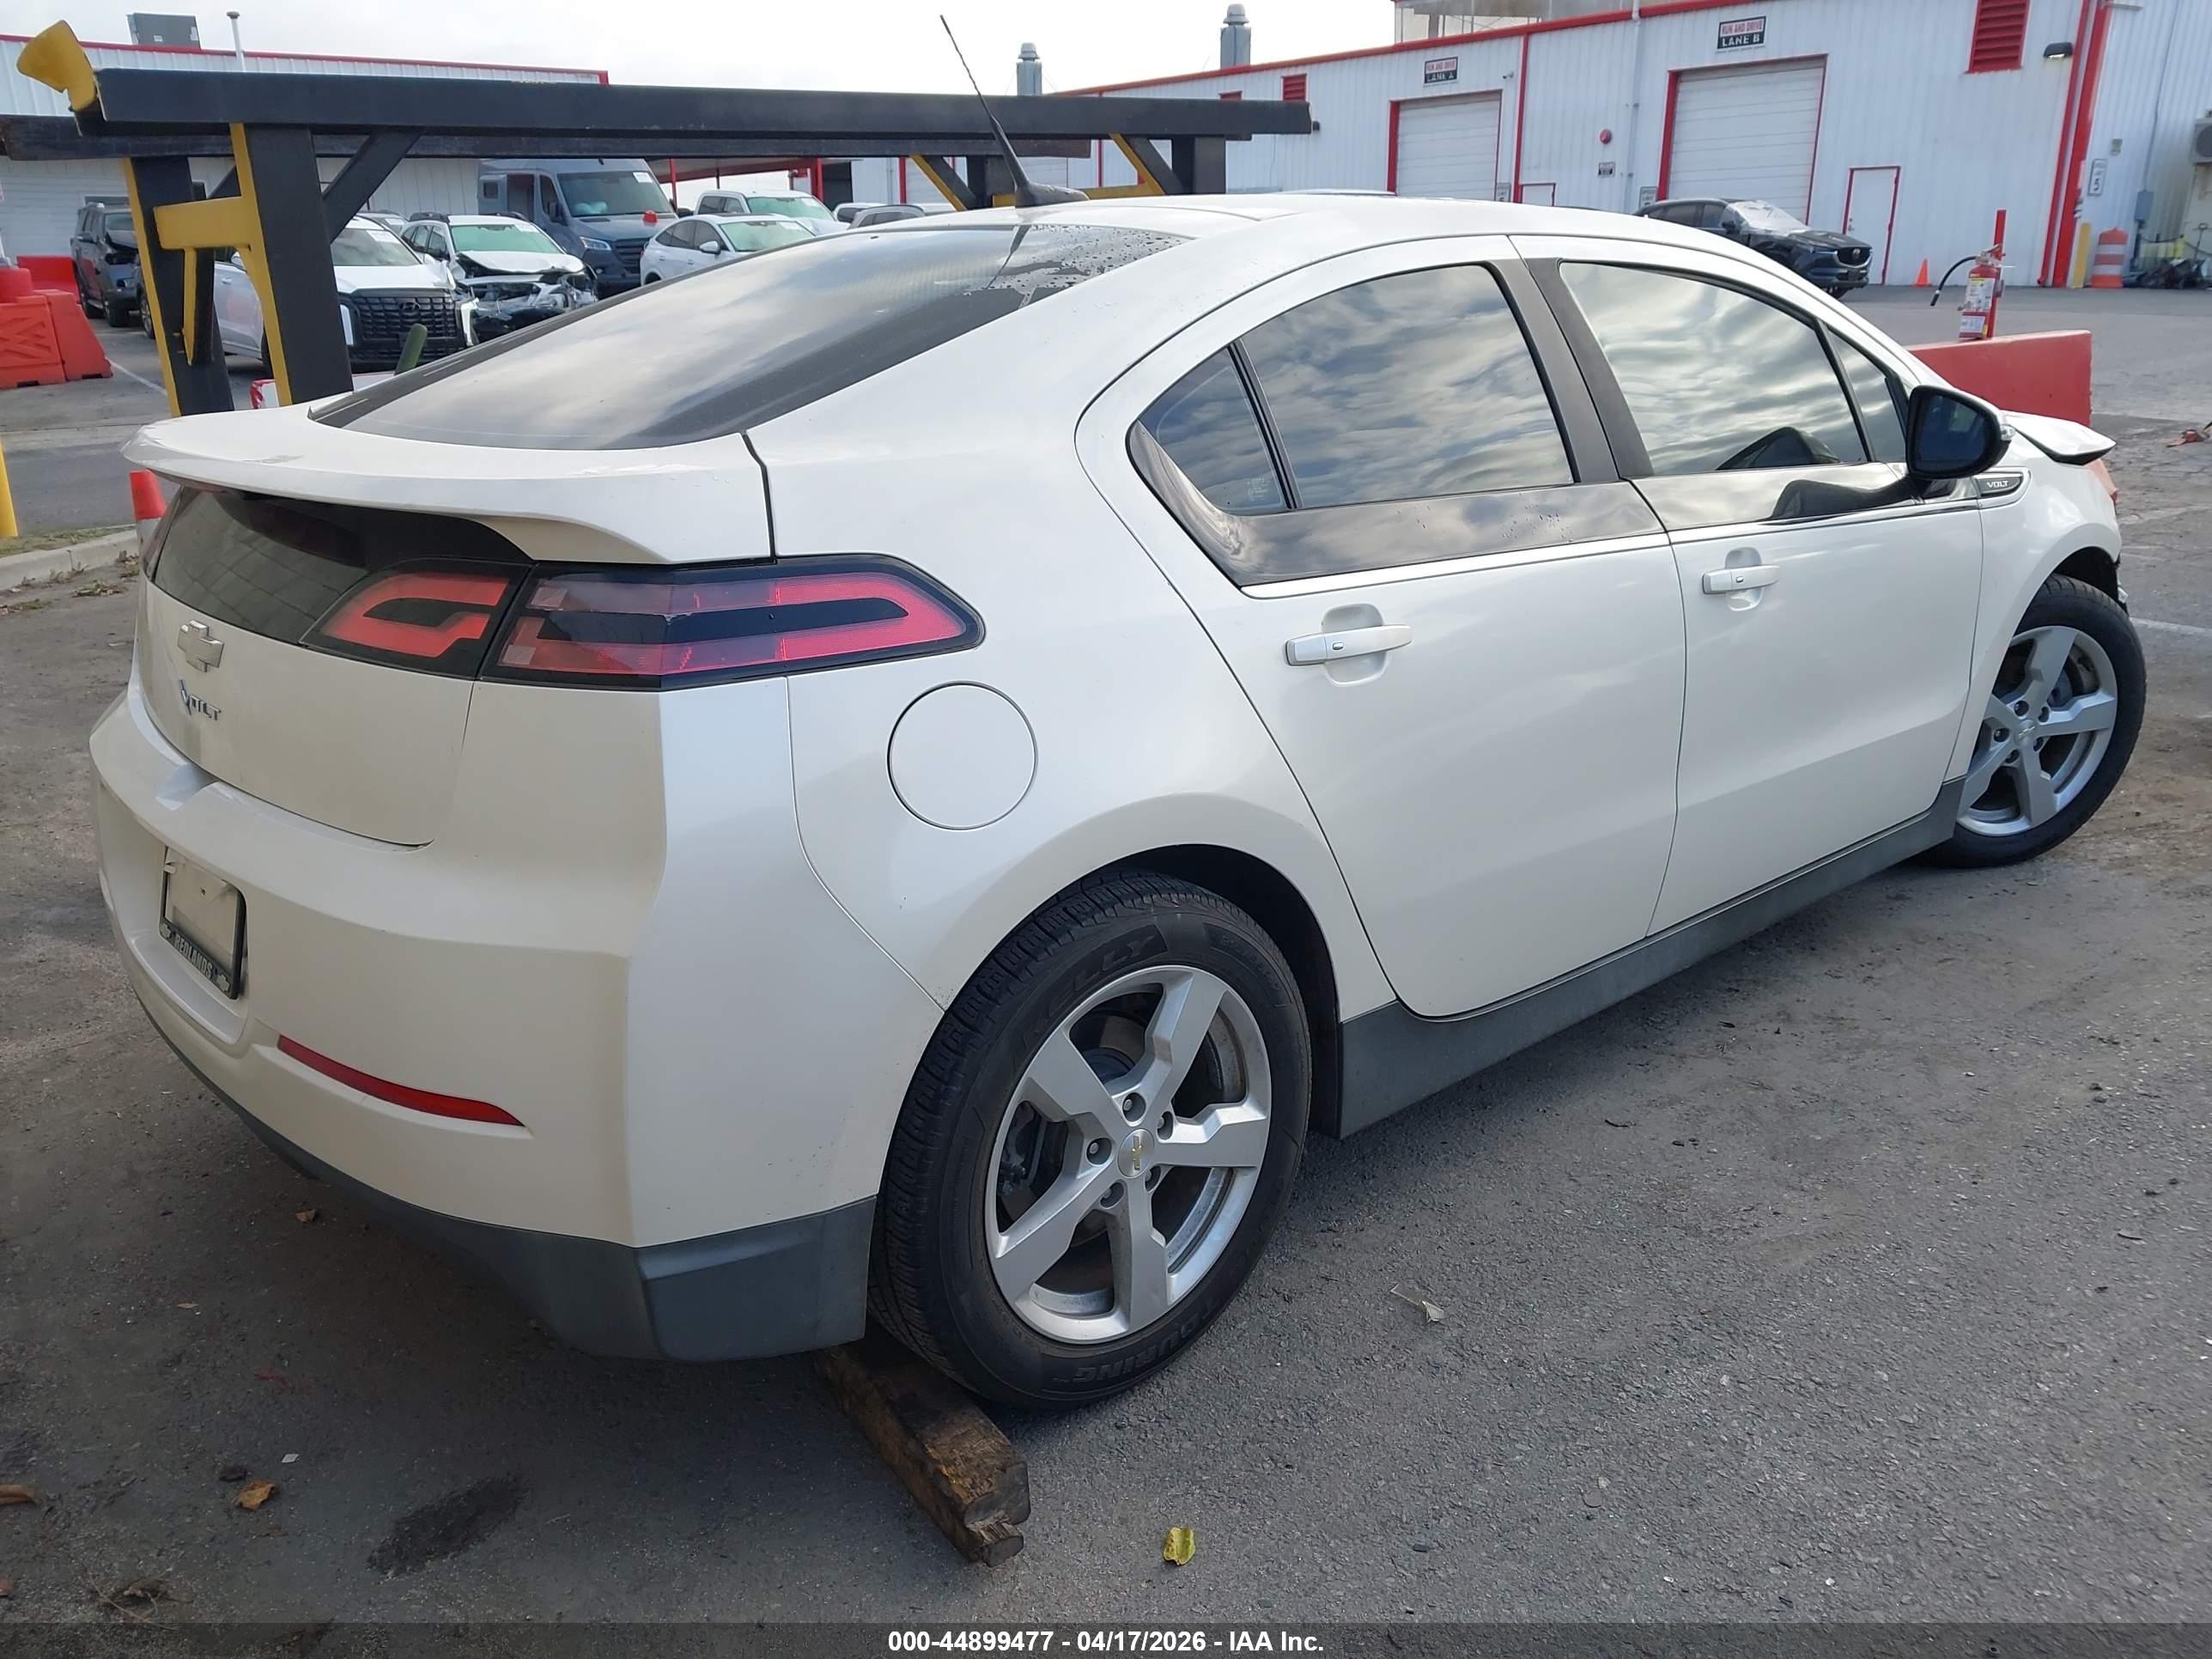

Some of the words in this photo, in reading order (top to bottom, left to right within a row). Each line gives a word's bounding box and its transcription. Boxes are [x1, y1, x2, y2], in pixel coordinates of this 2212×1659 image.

[1722, 35, 1749, 46] LANE
[1753, 33, 1760, 43] B
[2094, 178, 2100, 191] 5
[1986, 480, 2009, 489] VOLT
[179, 679, 222, 721] VOLT
[173, 933, 213, 980] REDLANDS
